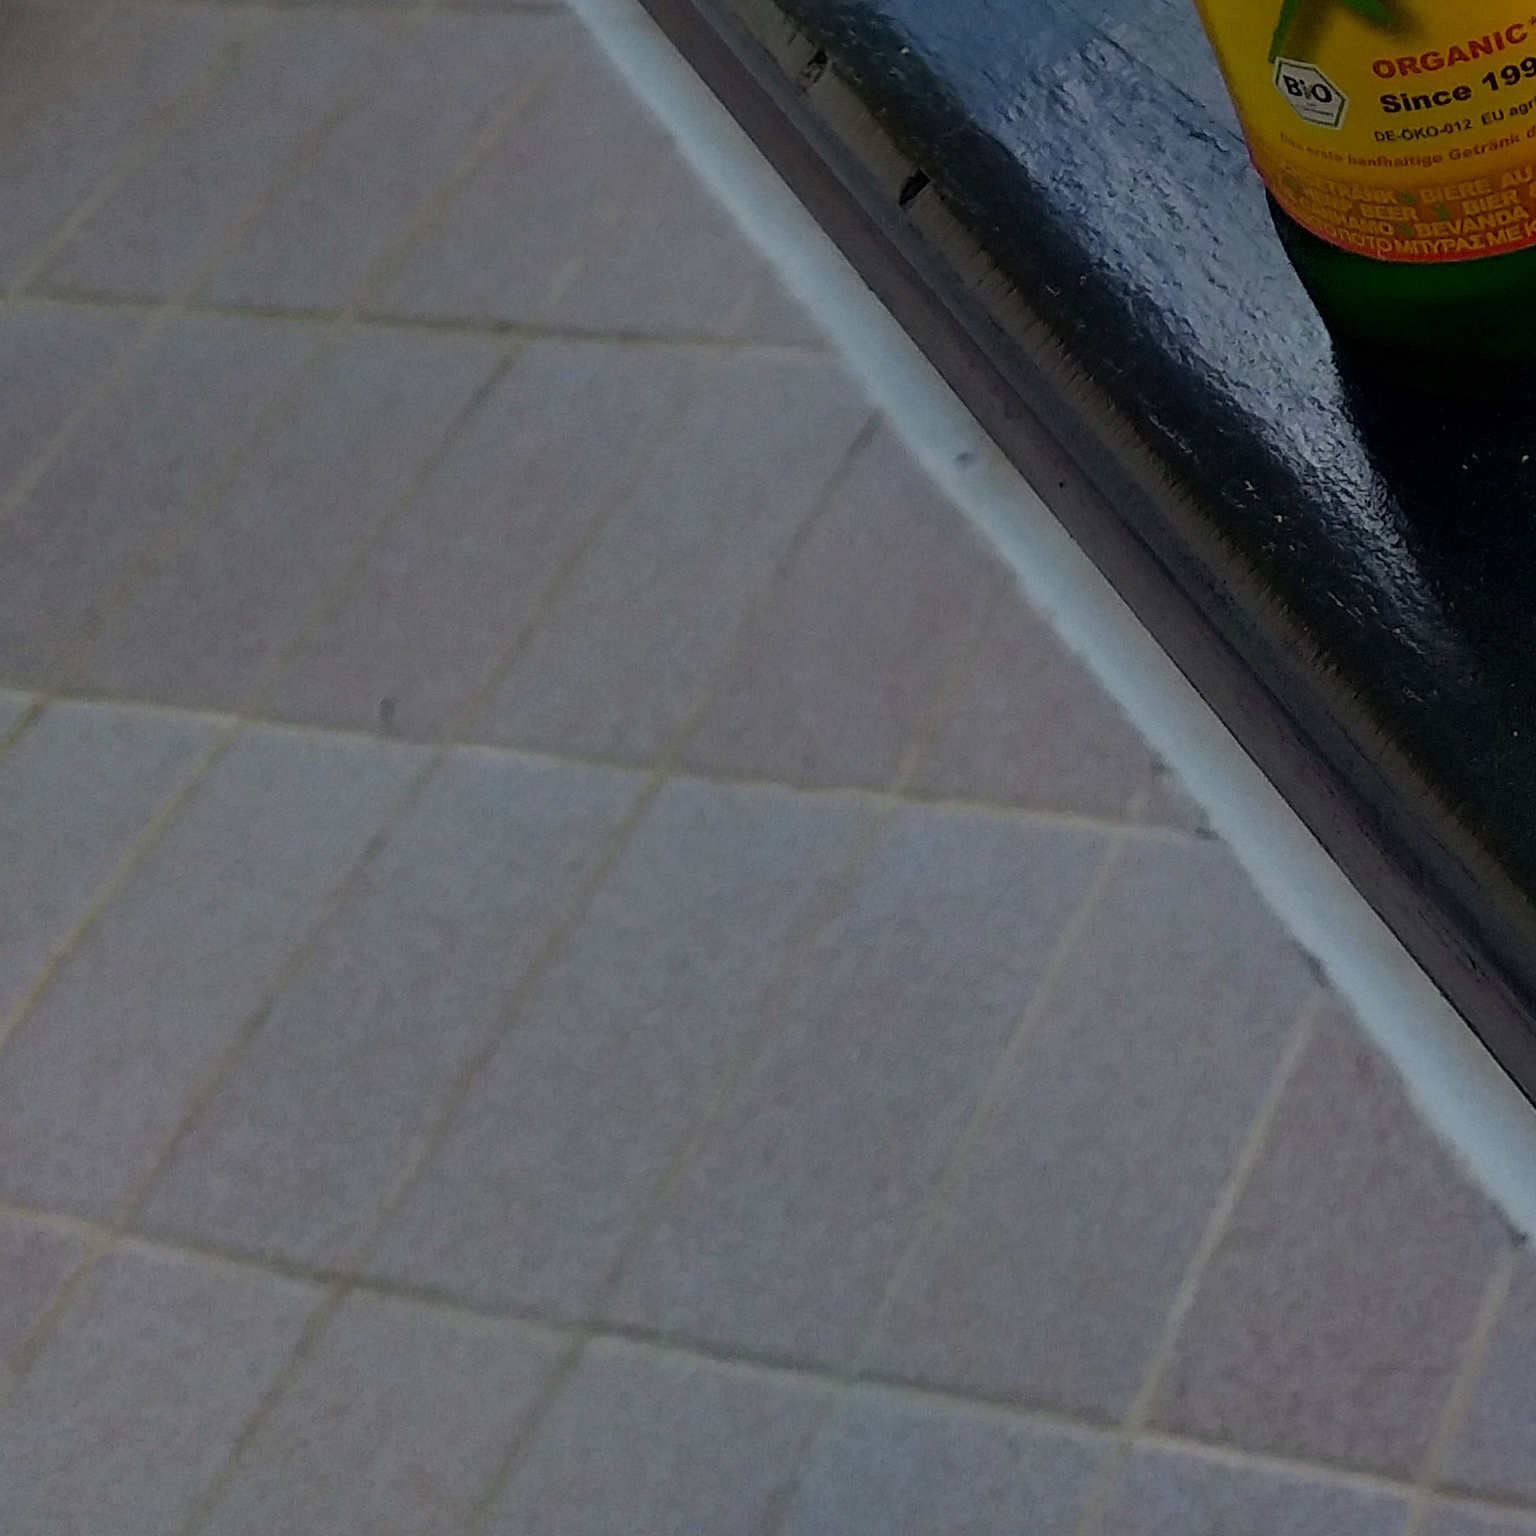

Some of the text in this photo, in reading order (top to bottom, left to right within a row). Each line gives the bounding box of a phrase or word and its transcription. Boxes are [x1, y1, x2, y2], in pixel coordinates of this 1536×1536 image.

[1379, 85, 1473, 114] Since
[1374, 117, 1474, 143] DE-ÖKO-012
[1480, 111, 1504, 126] EU
[1448, 132, 1522, 162] Getränk
[1501, 165, 1534, 189] AU
[1461, 189, 1521, 217] BIER
[1414, 204, 1531, 238] BEVANDA
